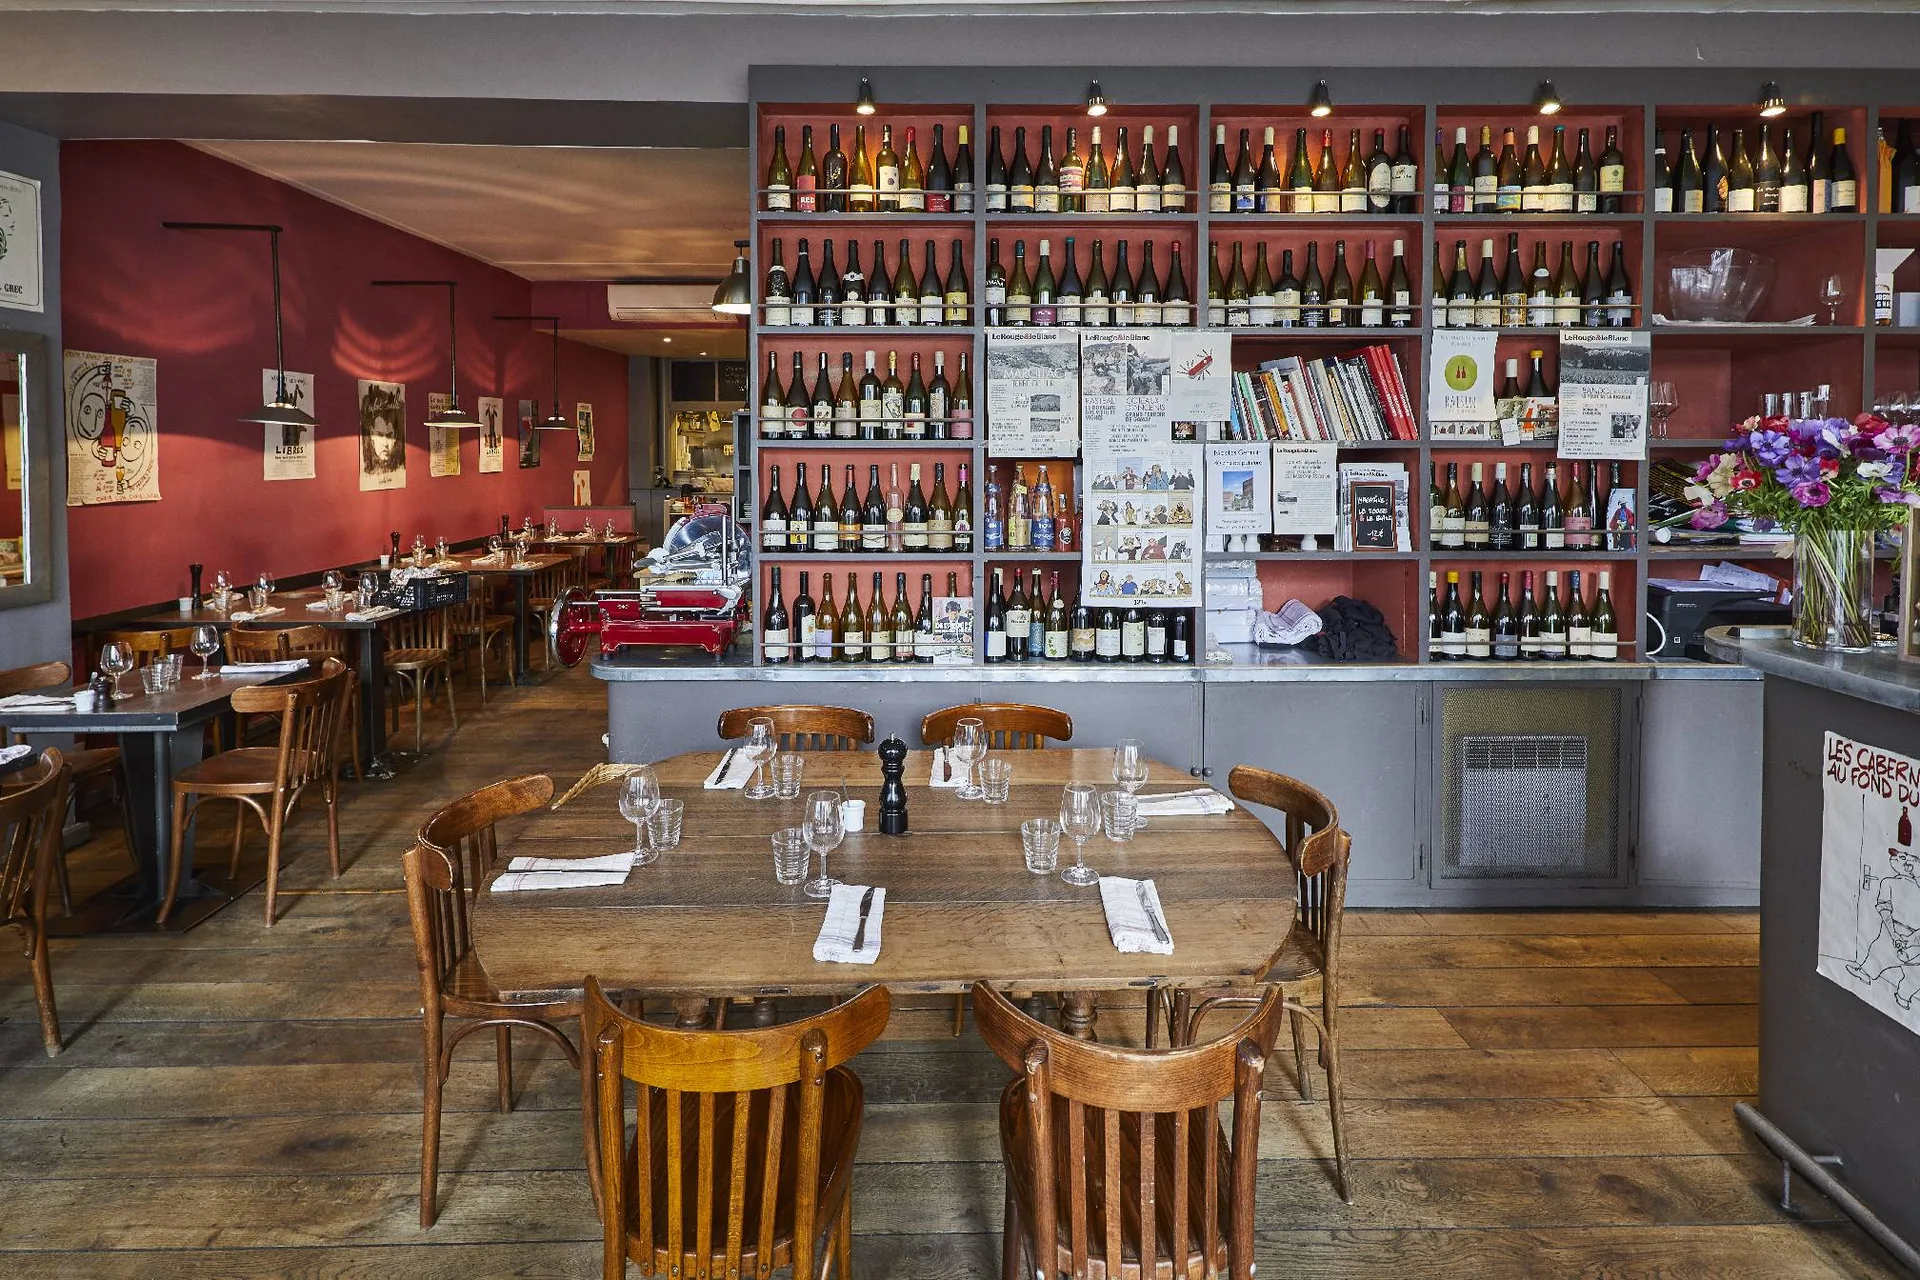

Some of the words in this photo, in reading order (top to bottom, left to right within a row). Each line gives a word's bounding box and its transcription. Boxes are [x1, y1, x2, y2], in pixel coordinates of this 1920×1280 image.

[4, 283, 23, 294] GREC
[1564, 333, 1629, 342] LeRouge&leBlanc
[1003, 367, 1066, 379] MARCILLAC
[1126, 397, 1160, 405] COTEAUX
[275, 445, 304, 455] LIBRES
[1828, 738, 1853, 766] LES
[1857, 748, 1920, 789] CABERN
[1827, 762, 1847, 784] AU
[1850, 767, 1892, 798] FOND
[1898, 784, 1920, 807] DU
